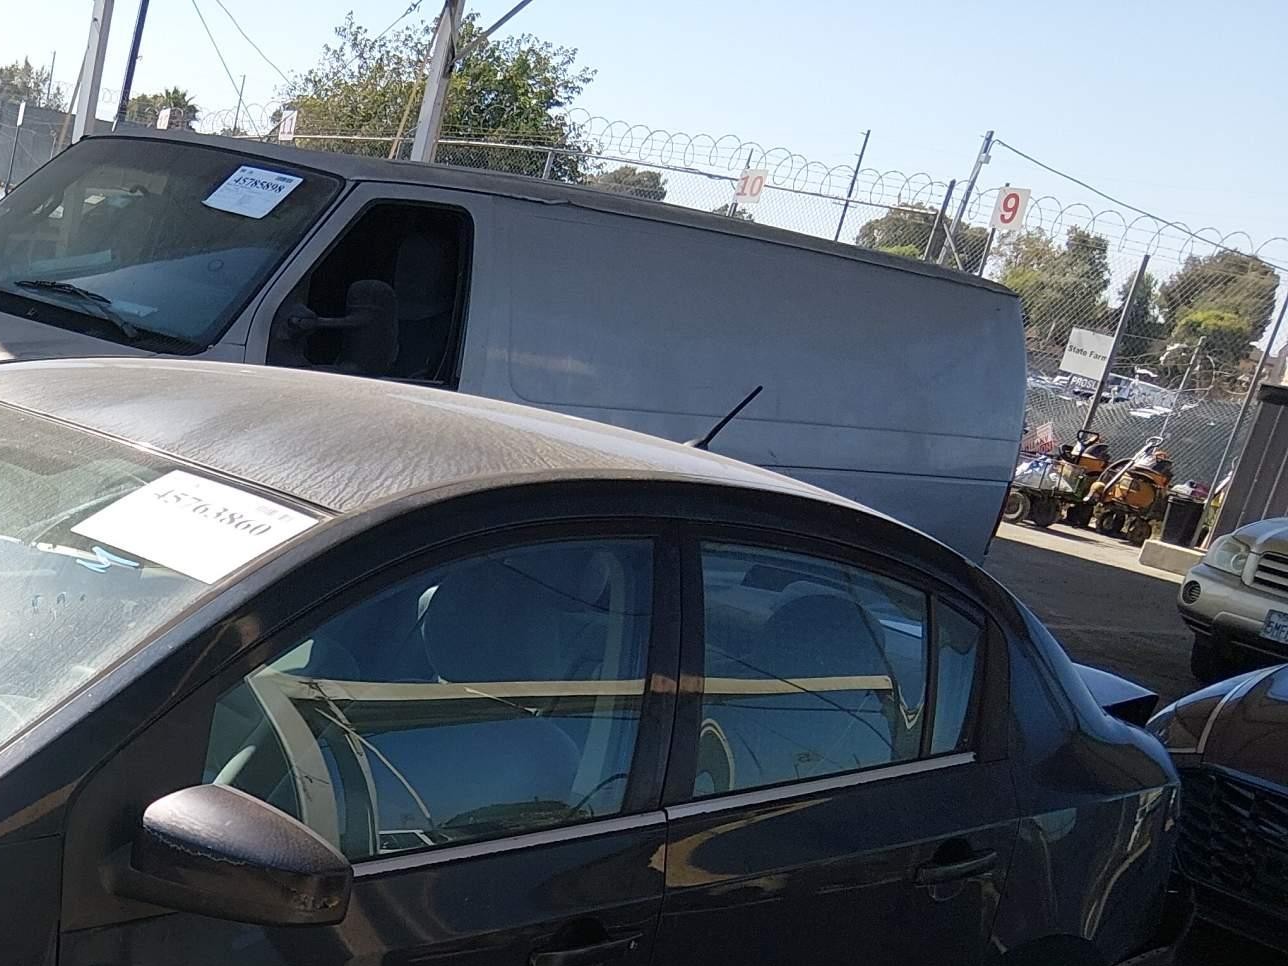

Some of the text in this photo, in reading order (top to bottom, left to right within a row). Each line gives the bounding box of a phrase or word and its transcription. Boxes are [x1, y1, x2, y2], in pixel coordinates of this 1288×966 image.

[234, 176, 285, 193] 45785898
[736, 175, 764, 197] 10
[999, 192, 1020, 224] 9
[1067, 344, 1088, 357] State
[154, 489, 272, 536] 45763860
